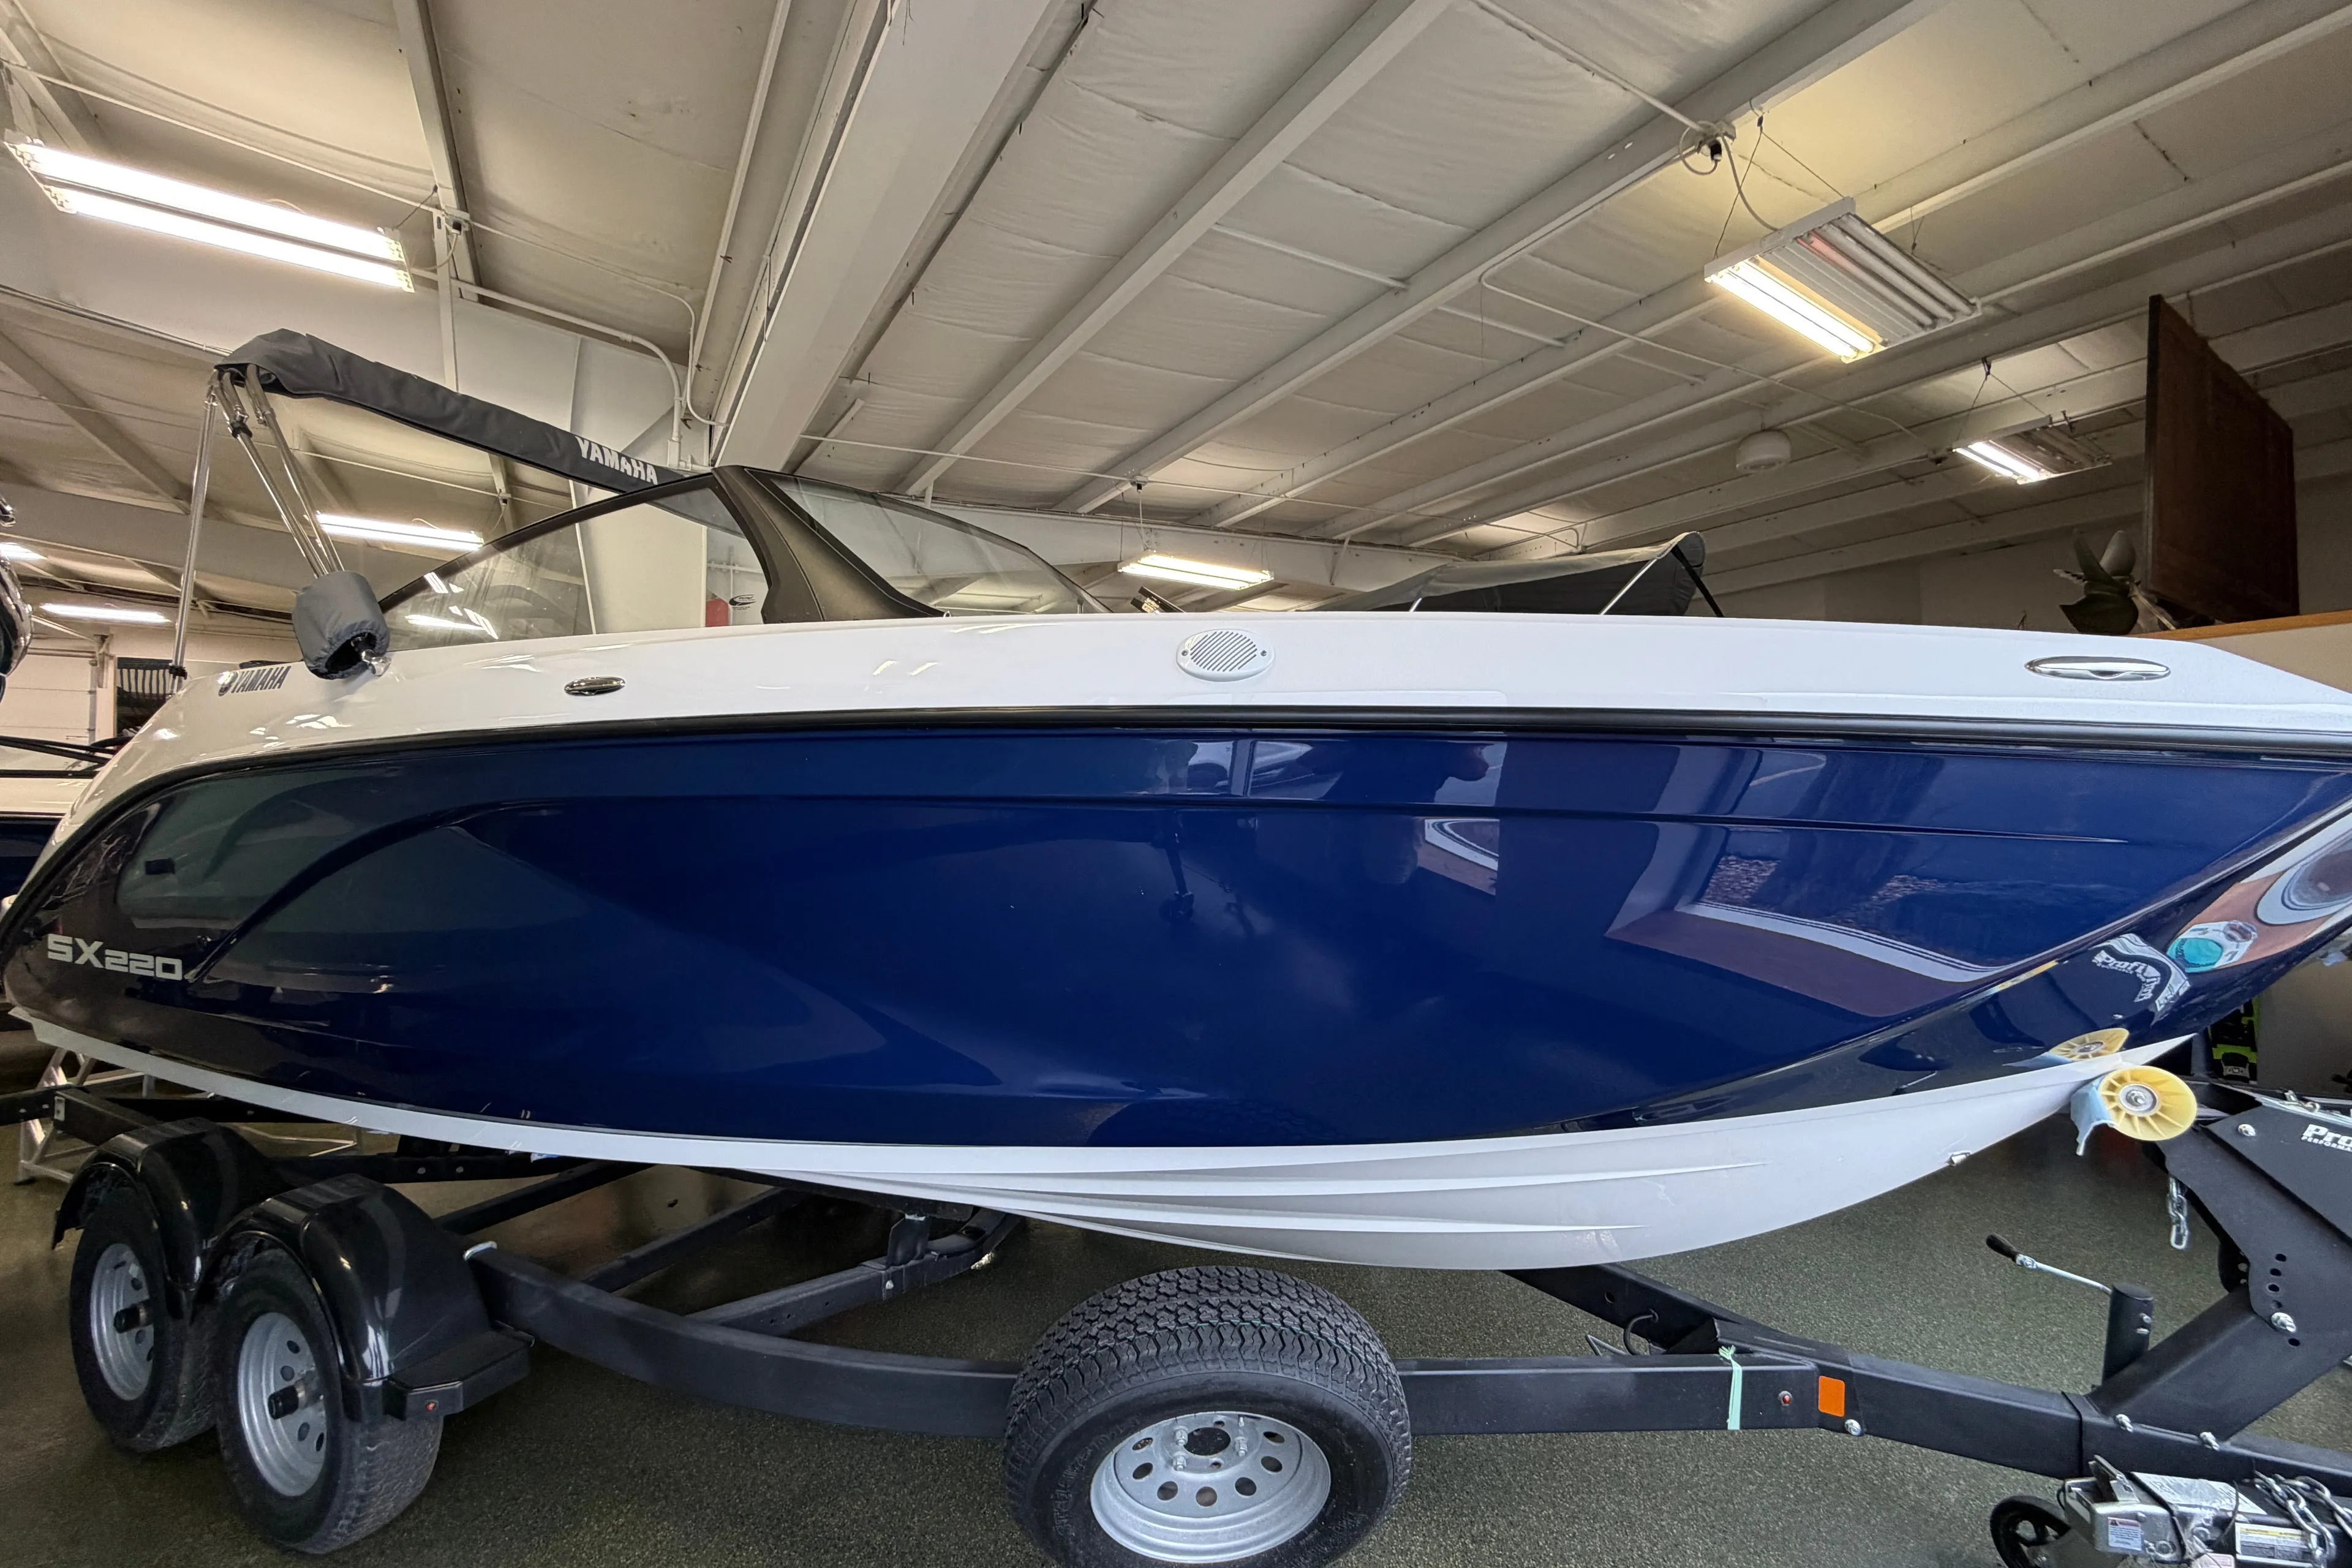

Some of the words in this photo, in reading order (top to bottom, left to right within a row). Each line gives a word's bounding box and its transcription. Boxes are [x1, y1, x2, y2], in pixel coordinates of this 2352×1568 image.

[575, 435, 658, 485] YAMAHA
[231, 666, 292, 693] YAMAHA
[48, 933, 183, 981] SX220
[2302, 1124, 2352, 1147] Pro
